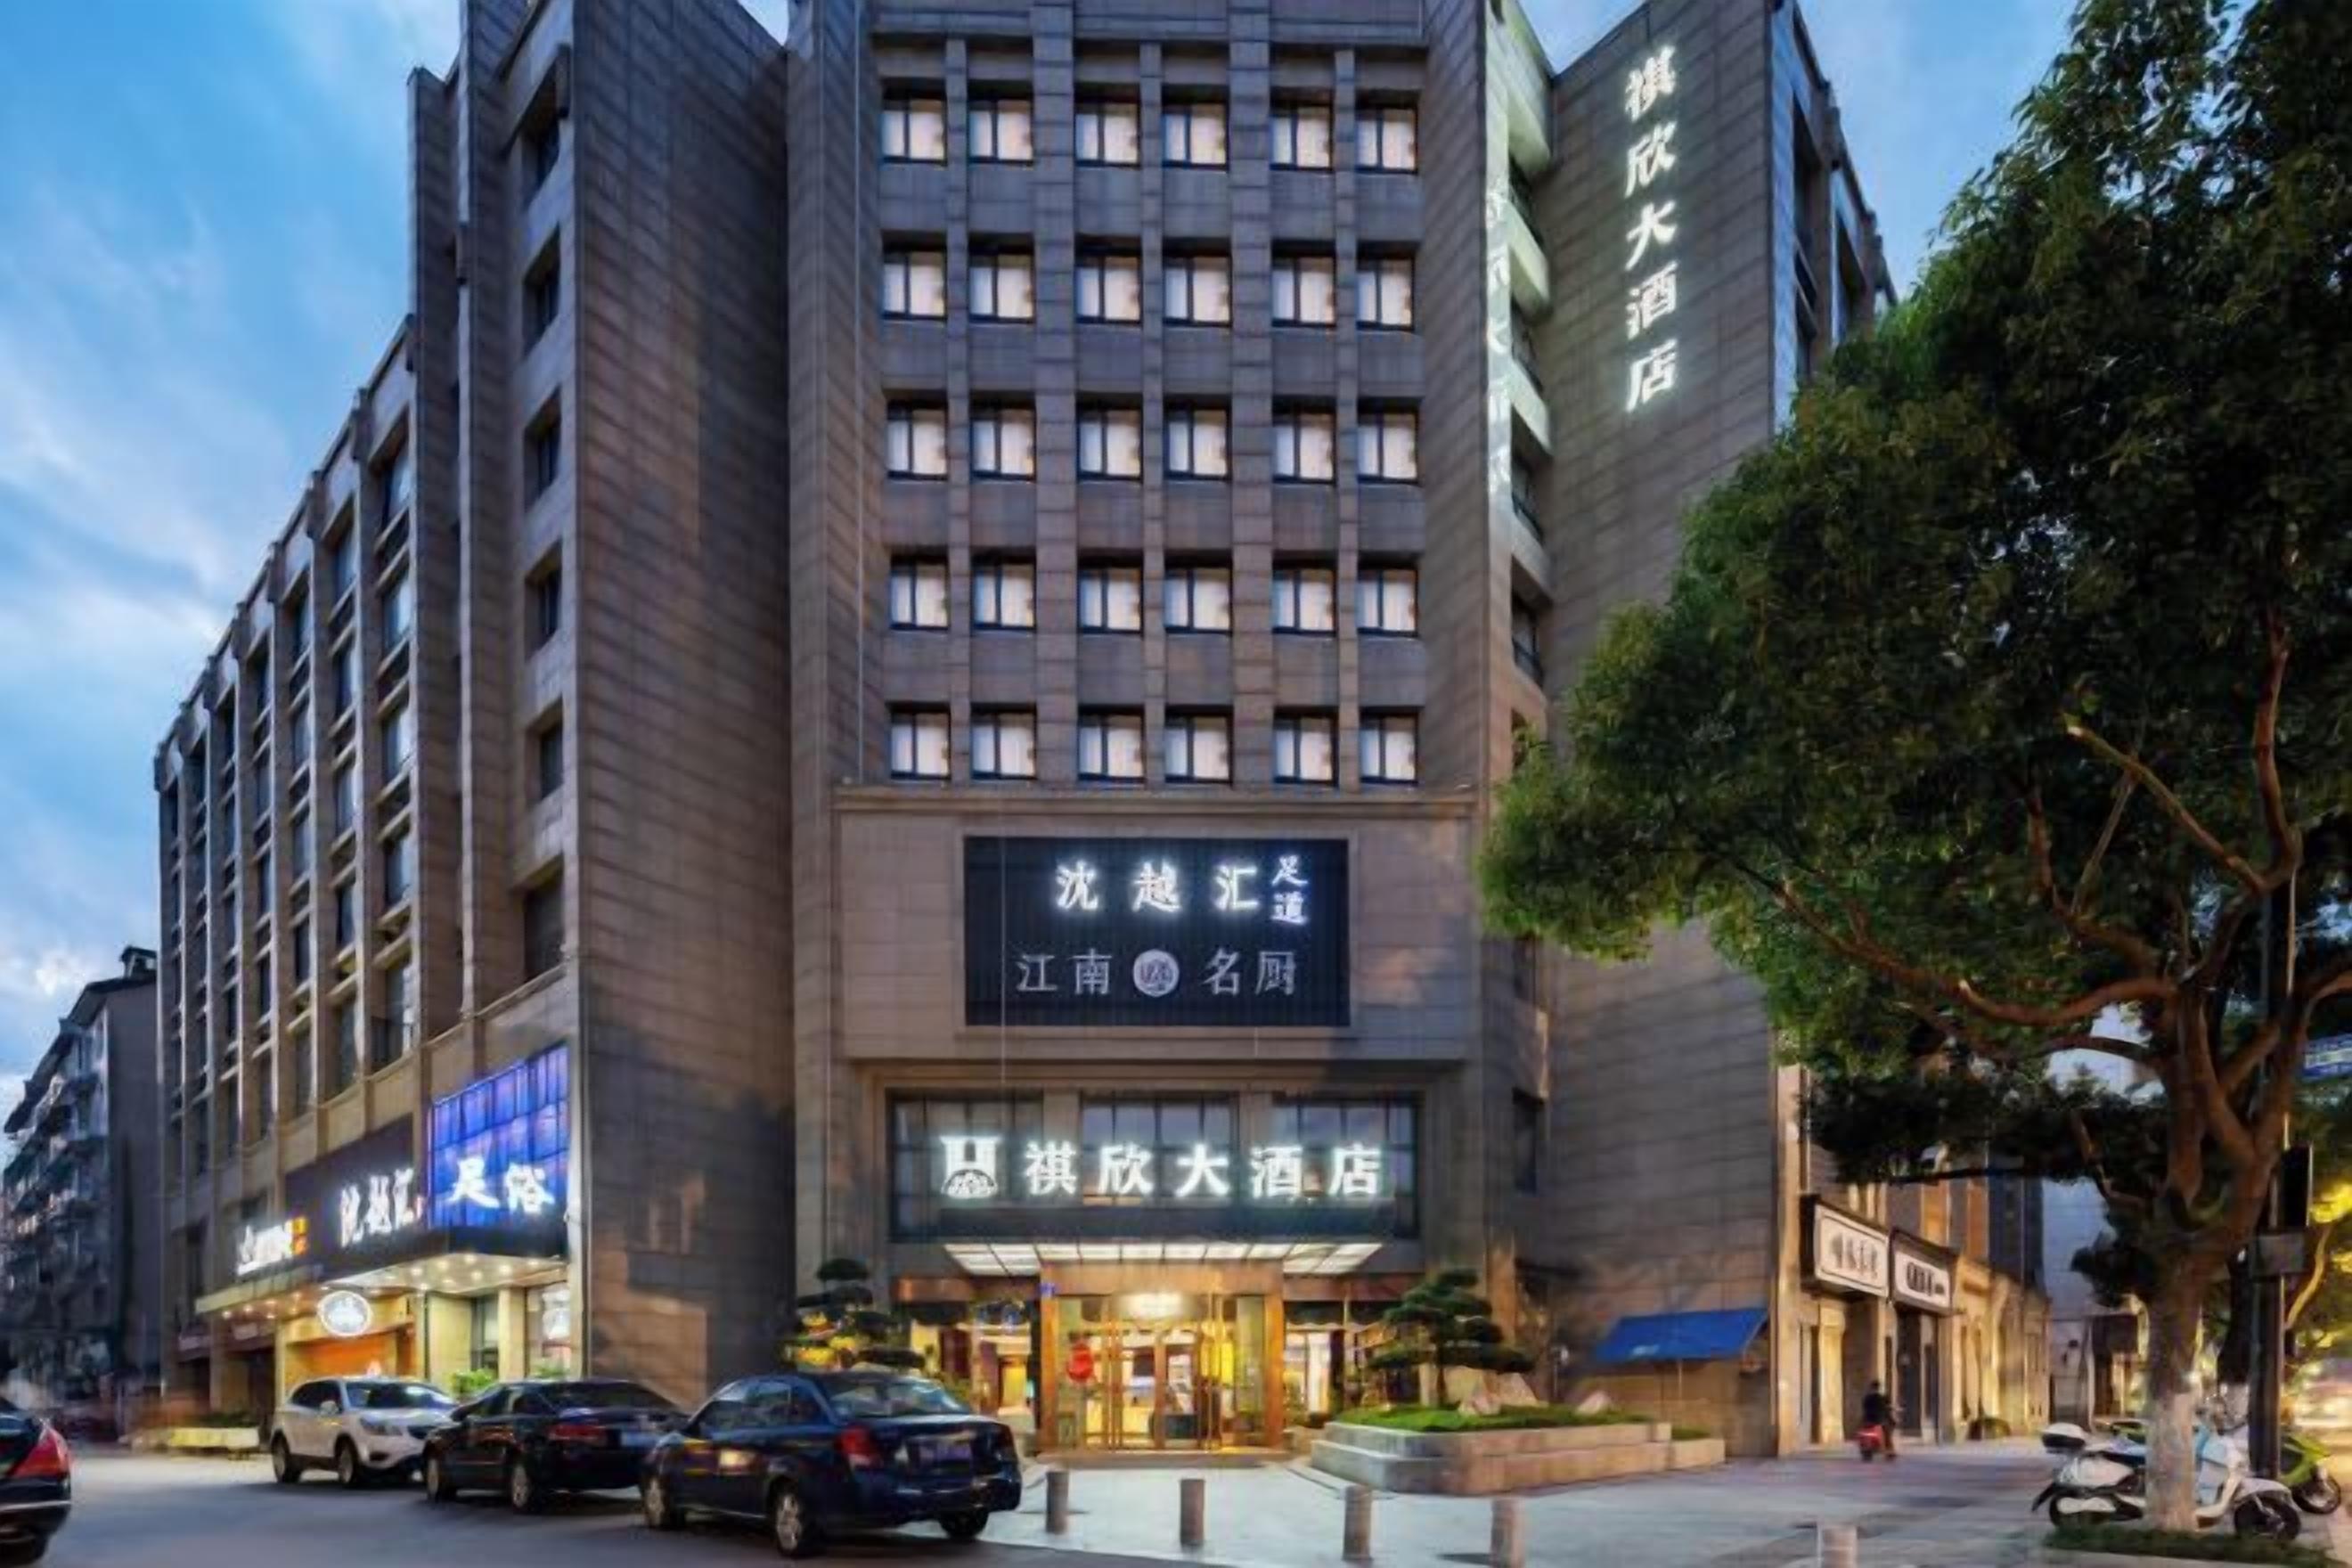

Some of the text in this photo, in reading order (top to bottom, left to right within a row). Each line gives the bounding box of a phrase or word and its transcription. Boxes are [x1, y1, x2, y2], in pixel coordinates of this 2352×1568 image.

[1056, 861, 1260, 912] 沈越汇
[1017, 948, 1112, 995] 江南
[1203, 947, 1296, 995] 名厨
